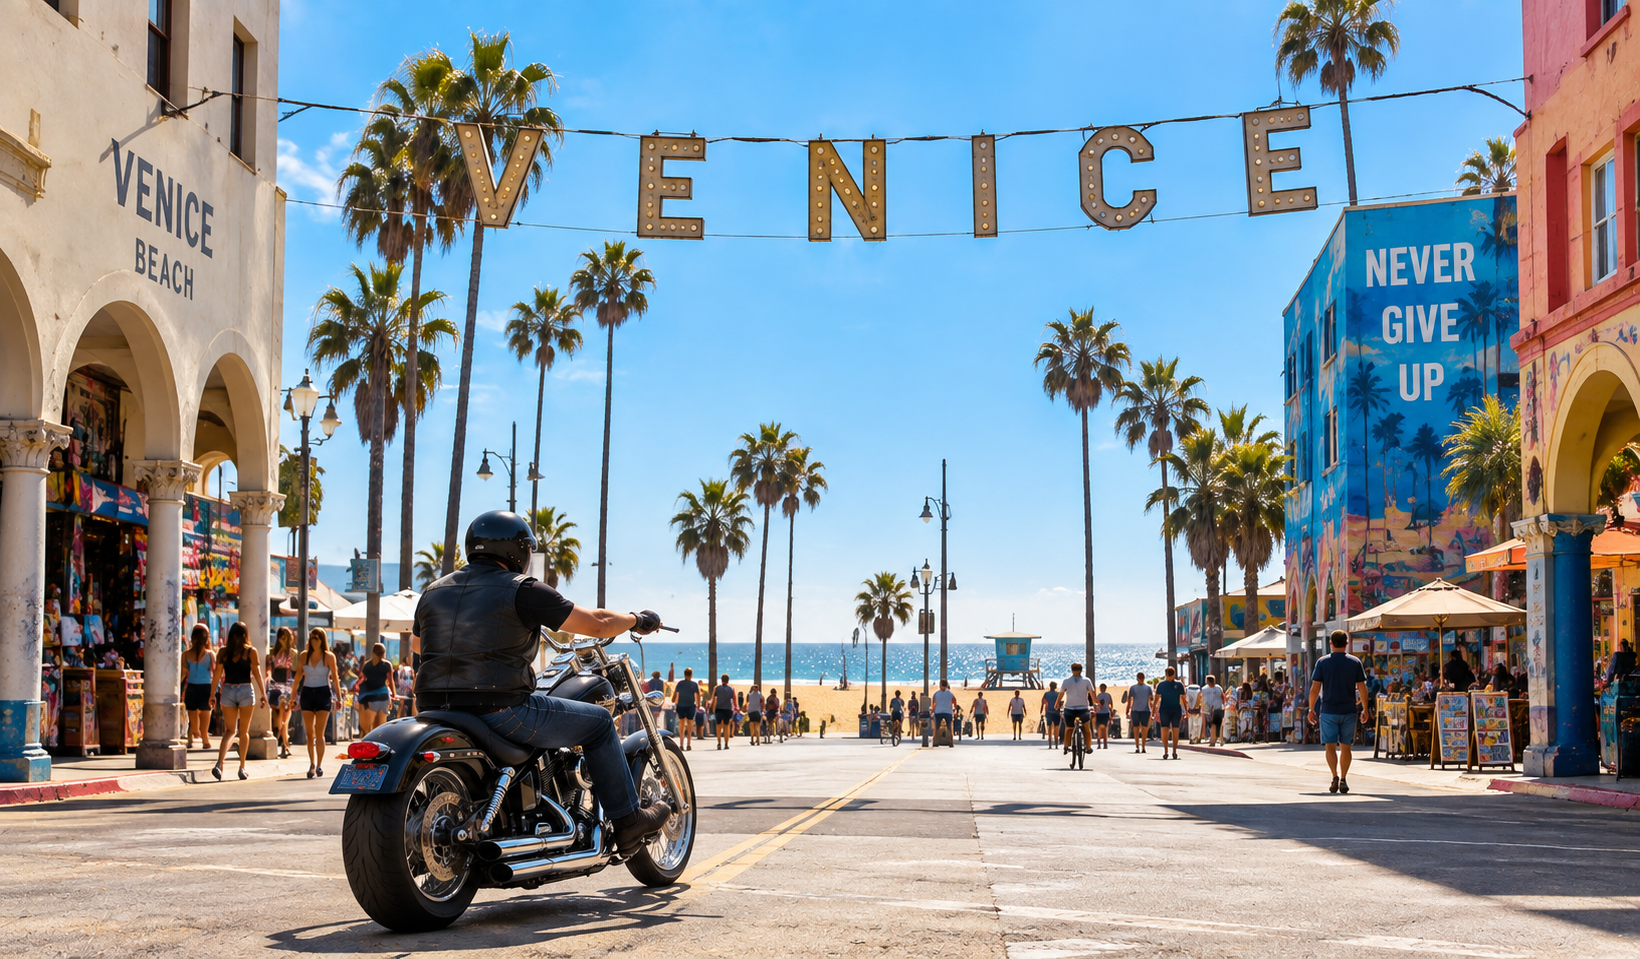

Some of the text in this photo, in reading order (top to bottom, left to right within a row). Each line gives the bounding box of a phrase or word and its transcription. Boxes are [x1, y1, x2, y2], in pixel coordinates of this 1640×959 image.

[111, 138, 214, 259] VENICE
[453, 105, 1318, 242] VENICE
[135, 237, 193, 301] BEACH
[1366, 242, 1476, 287] NEVER
[1382, 303, 1460, 345] GIVE
[1399, 362, 1445, 402] UP
